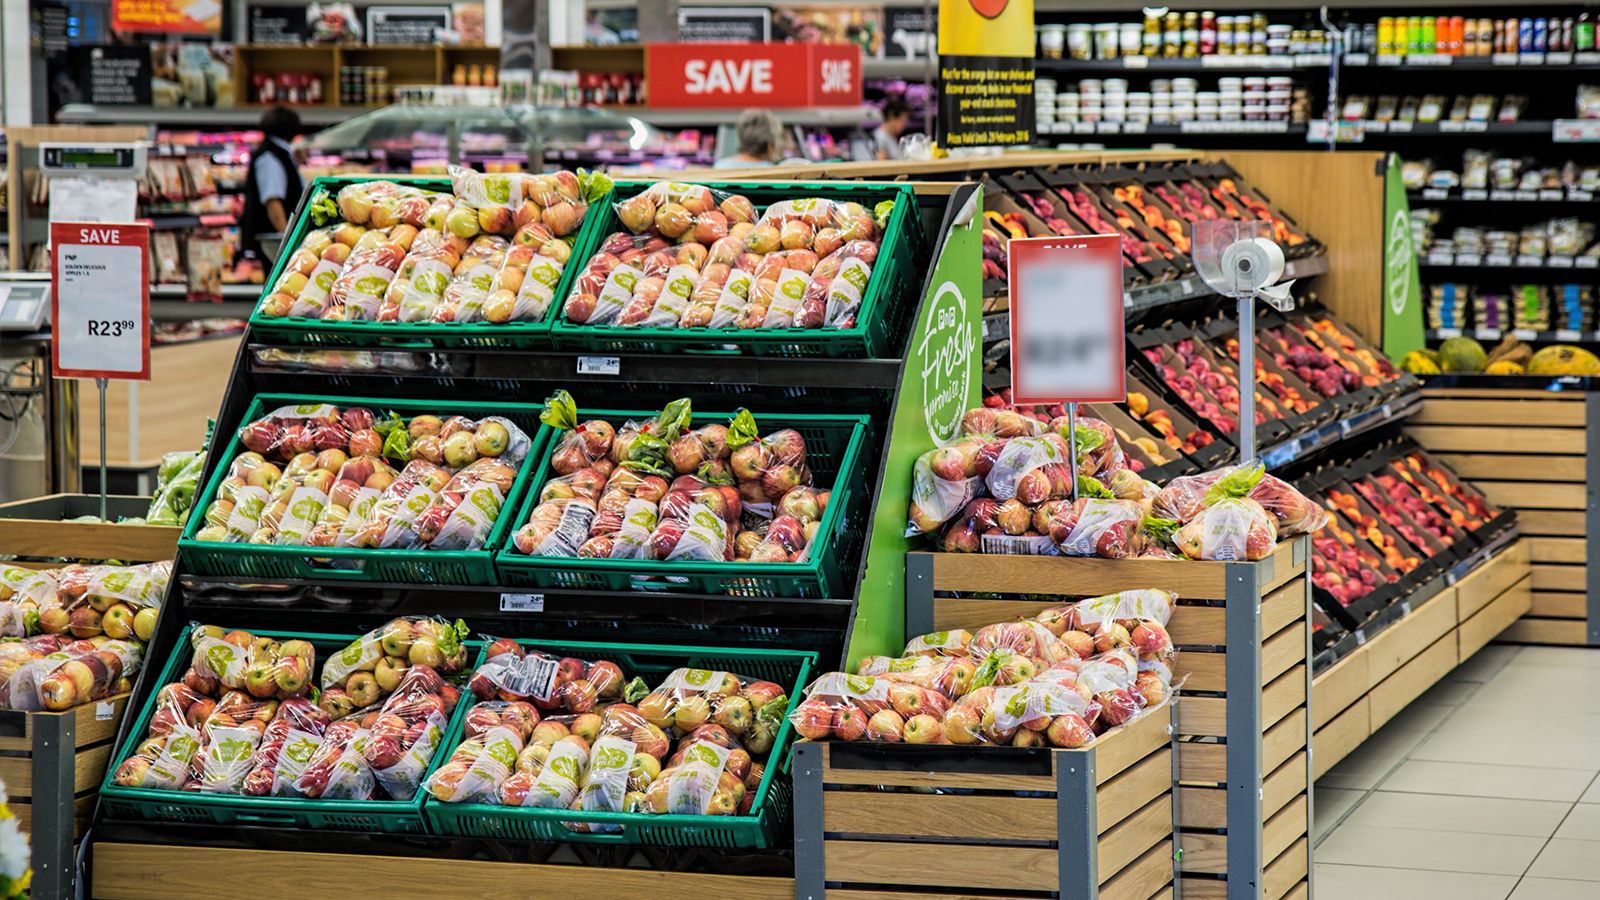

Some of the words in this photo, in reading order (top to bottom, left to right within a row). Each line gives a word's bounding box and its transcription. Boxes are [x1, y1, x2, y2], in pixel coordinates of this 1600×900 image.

[684, 58, 773, 94] SAVE
[821, 59, 852, 93] SAVE
[80, 228, 120, 244] SAVE
[938, 306, 956, 330] PnP
[918, 298, 976, 390] Fresh
[926, 380, 959, 422] promise
